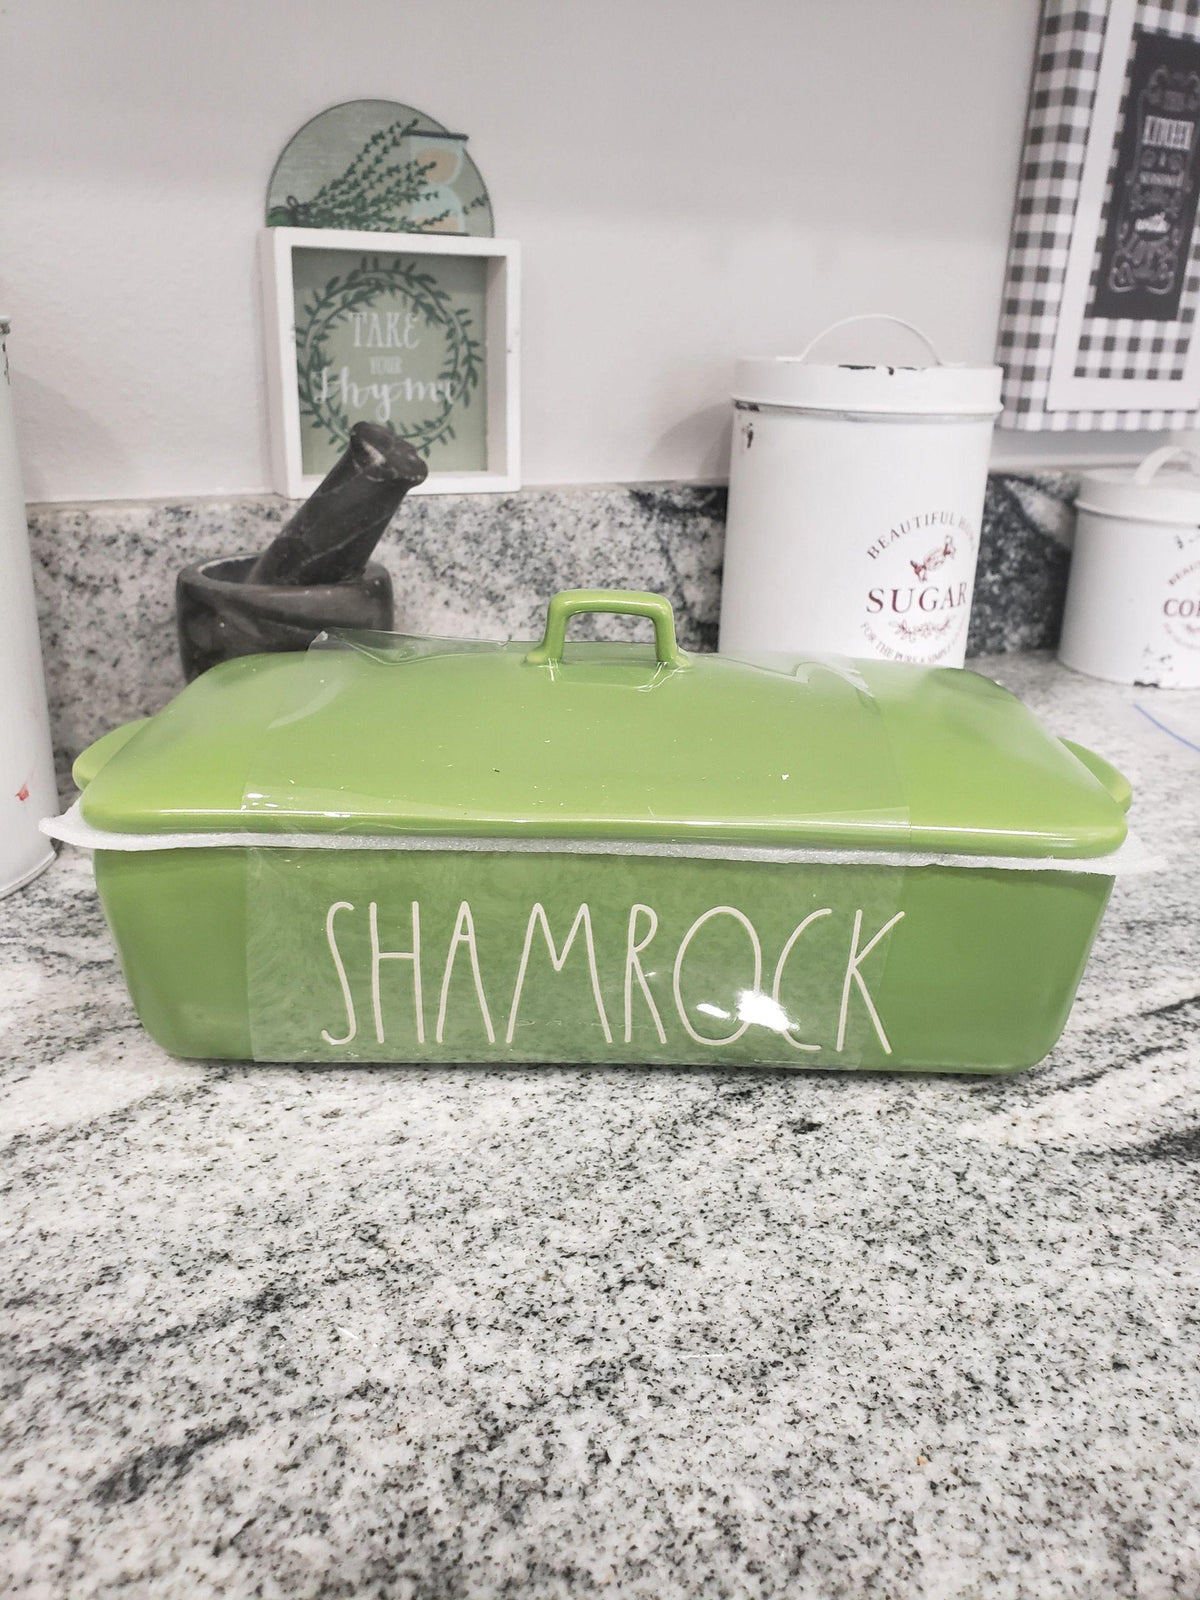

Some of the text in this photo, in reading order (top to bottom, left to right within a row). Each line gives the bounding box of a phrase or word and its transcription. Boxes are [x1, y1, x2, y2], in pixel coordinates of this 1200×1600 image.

[347, 311, 422, 349] TAKE
[867, 511, 955, 560] BEAUTIFUL
[866, 582, 968, 614] SUGAR
[321, 901, 906, 1054] SHAMROCK
